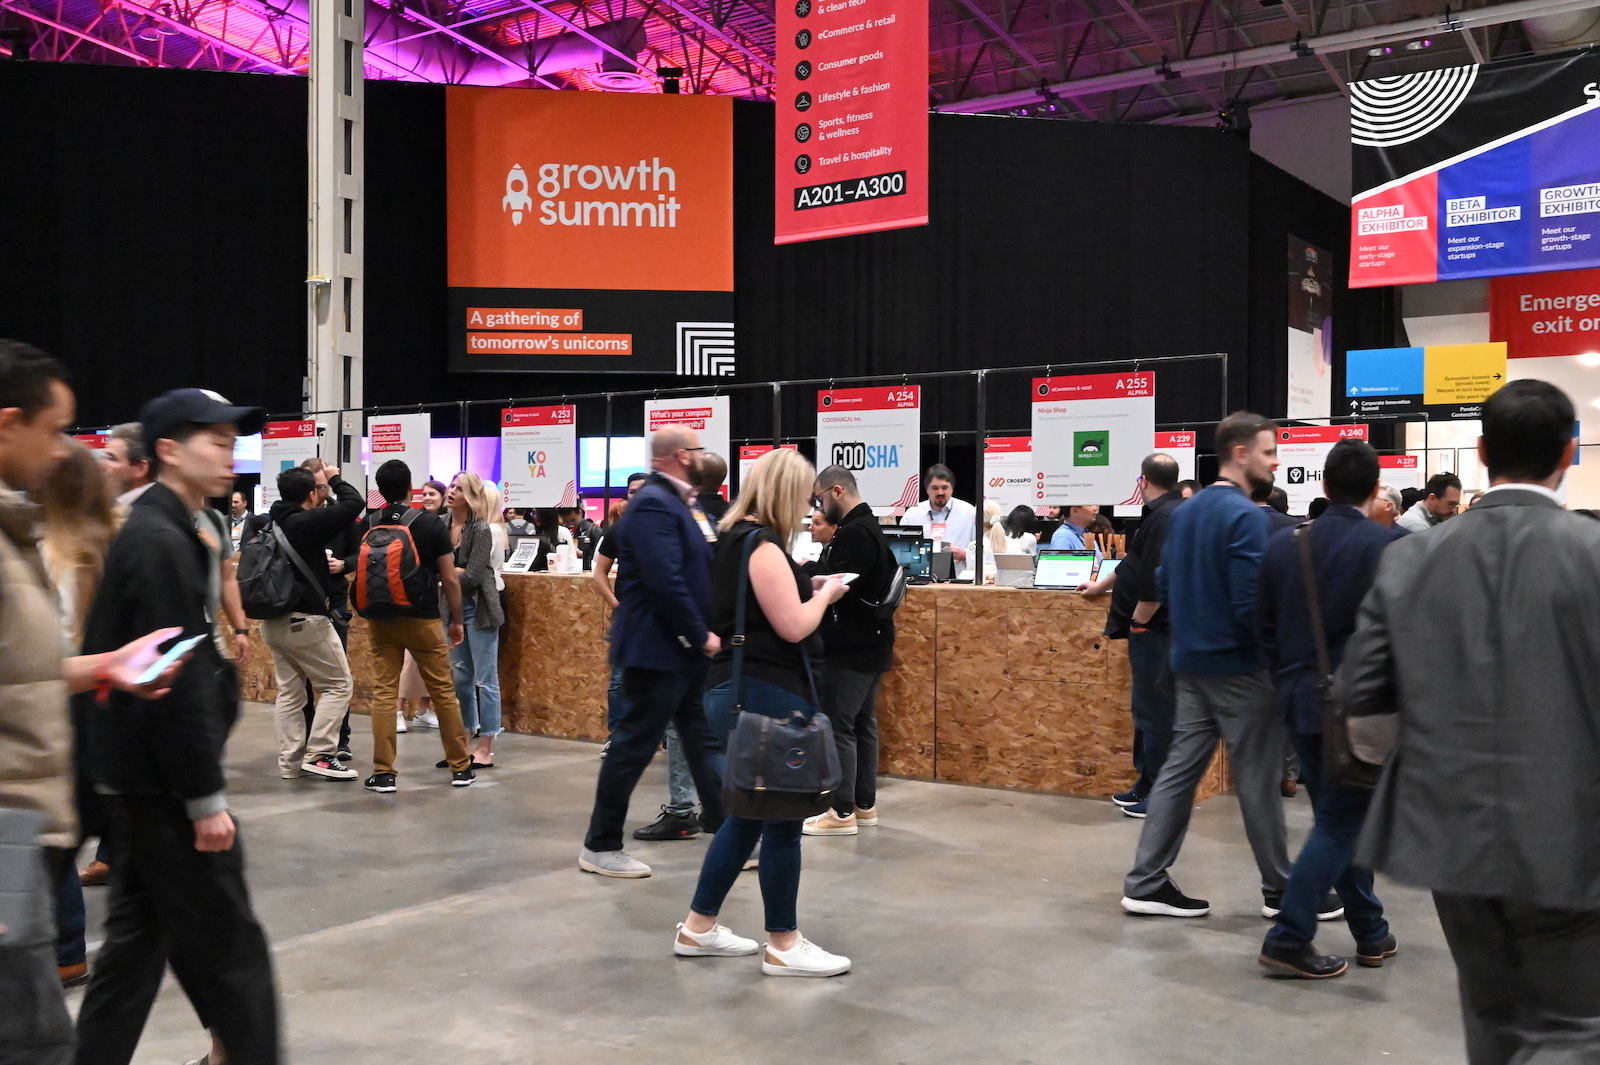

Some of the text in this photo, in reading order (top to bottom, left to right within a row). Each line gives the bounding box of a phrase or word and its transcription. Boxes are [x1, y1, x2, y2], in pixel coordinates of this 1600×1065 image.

[818, 6, 825, 14] &
[826, 2, 847, 12] clean
[818, 14, 896, 40] eCommerce & retail
[818, 51, 883, 71] Consumer goods
[818, 82, 890, 103] Lifestyle & fashion
[818, 112, 873, 129] Sports, fitness
[819, 126, 860, 141] & wellness
[819, 146, 892, 166] Travel & hospitality
[537, 157, 676, 198] growth
[539, 194, 681, 227] summit
[1451, 199, 1480, 211] BETA
[1362, 208, 1400, 220] ALPHA
[1451, 209, 1517, 224] EXHIBITOR
[1362, 219, 1424, 233] EXHIBITOR
[1542, 227, 1562, 235] Meet
[1542, 234, 1591, 244] growth-stage
[1448, 242, 1505, 252] expansion-stage
[1542, 243, 1572, 252] startups
[1359, 252, 1396, 260] early-stage
[1448, 252, 1476, 260] startups
[1520, 294, 1600, 312] Emerge
[470, 310, 580, 328] A gathering of
[1532, 315, 1574, 334] exit
[470, 335, 629, 350] tomorrow's unicorns
[1116, 378, 1148, 390] A 255
[888, 391, 914, 402] A 254
[552, 409, 571, 418] A 253
[1347, 428, 1364, 436] 240
